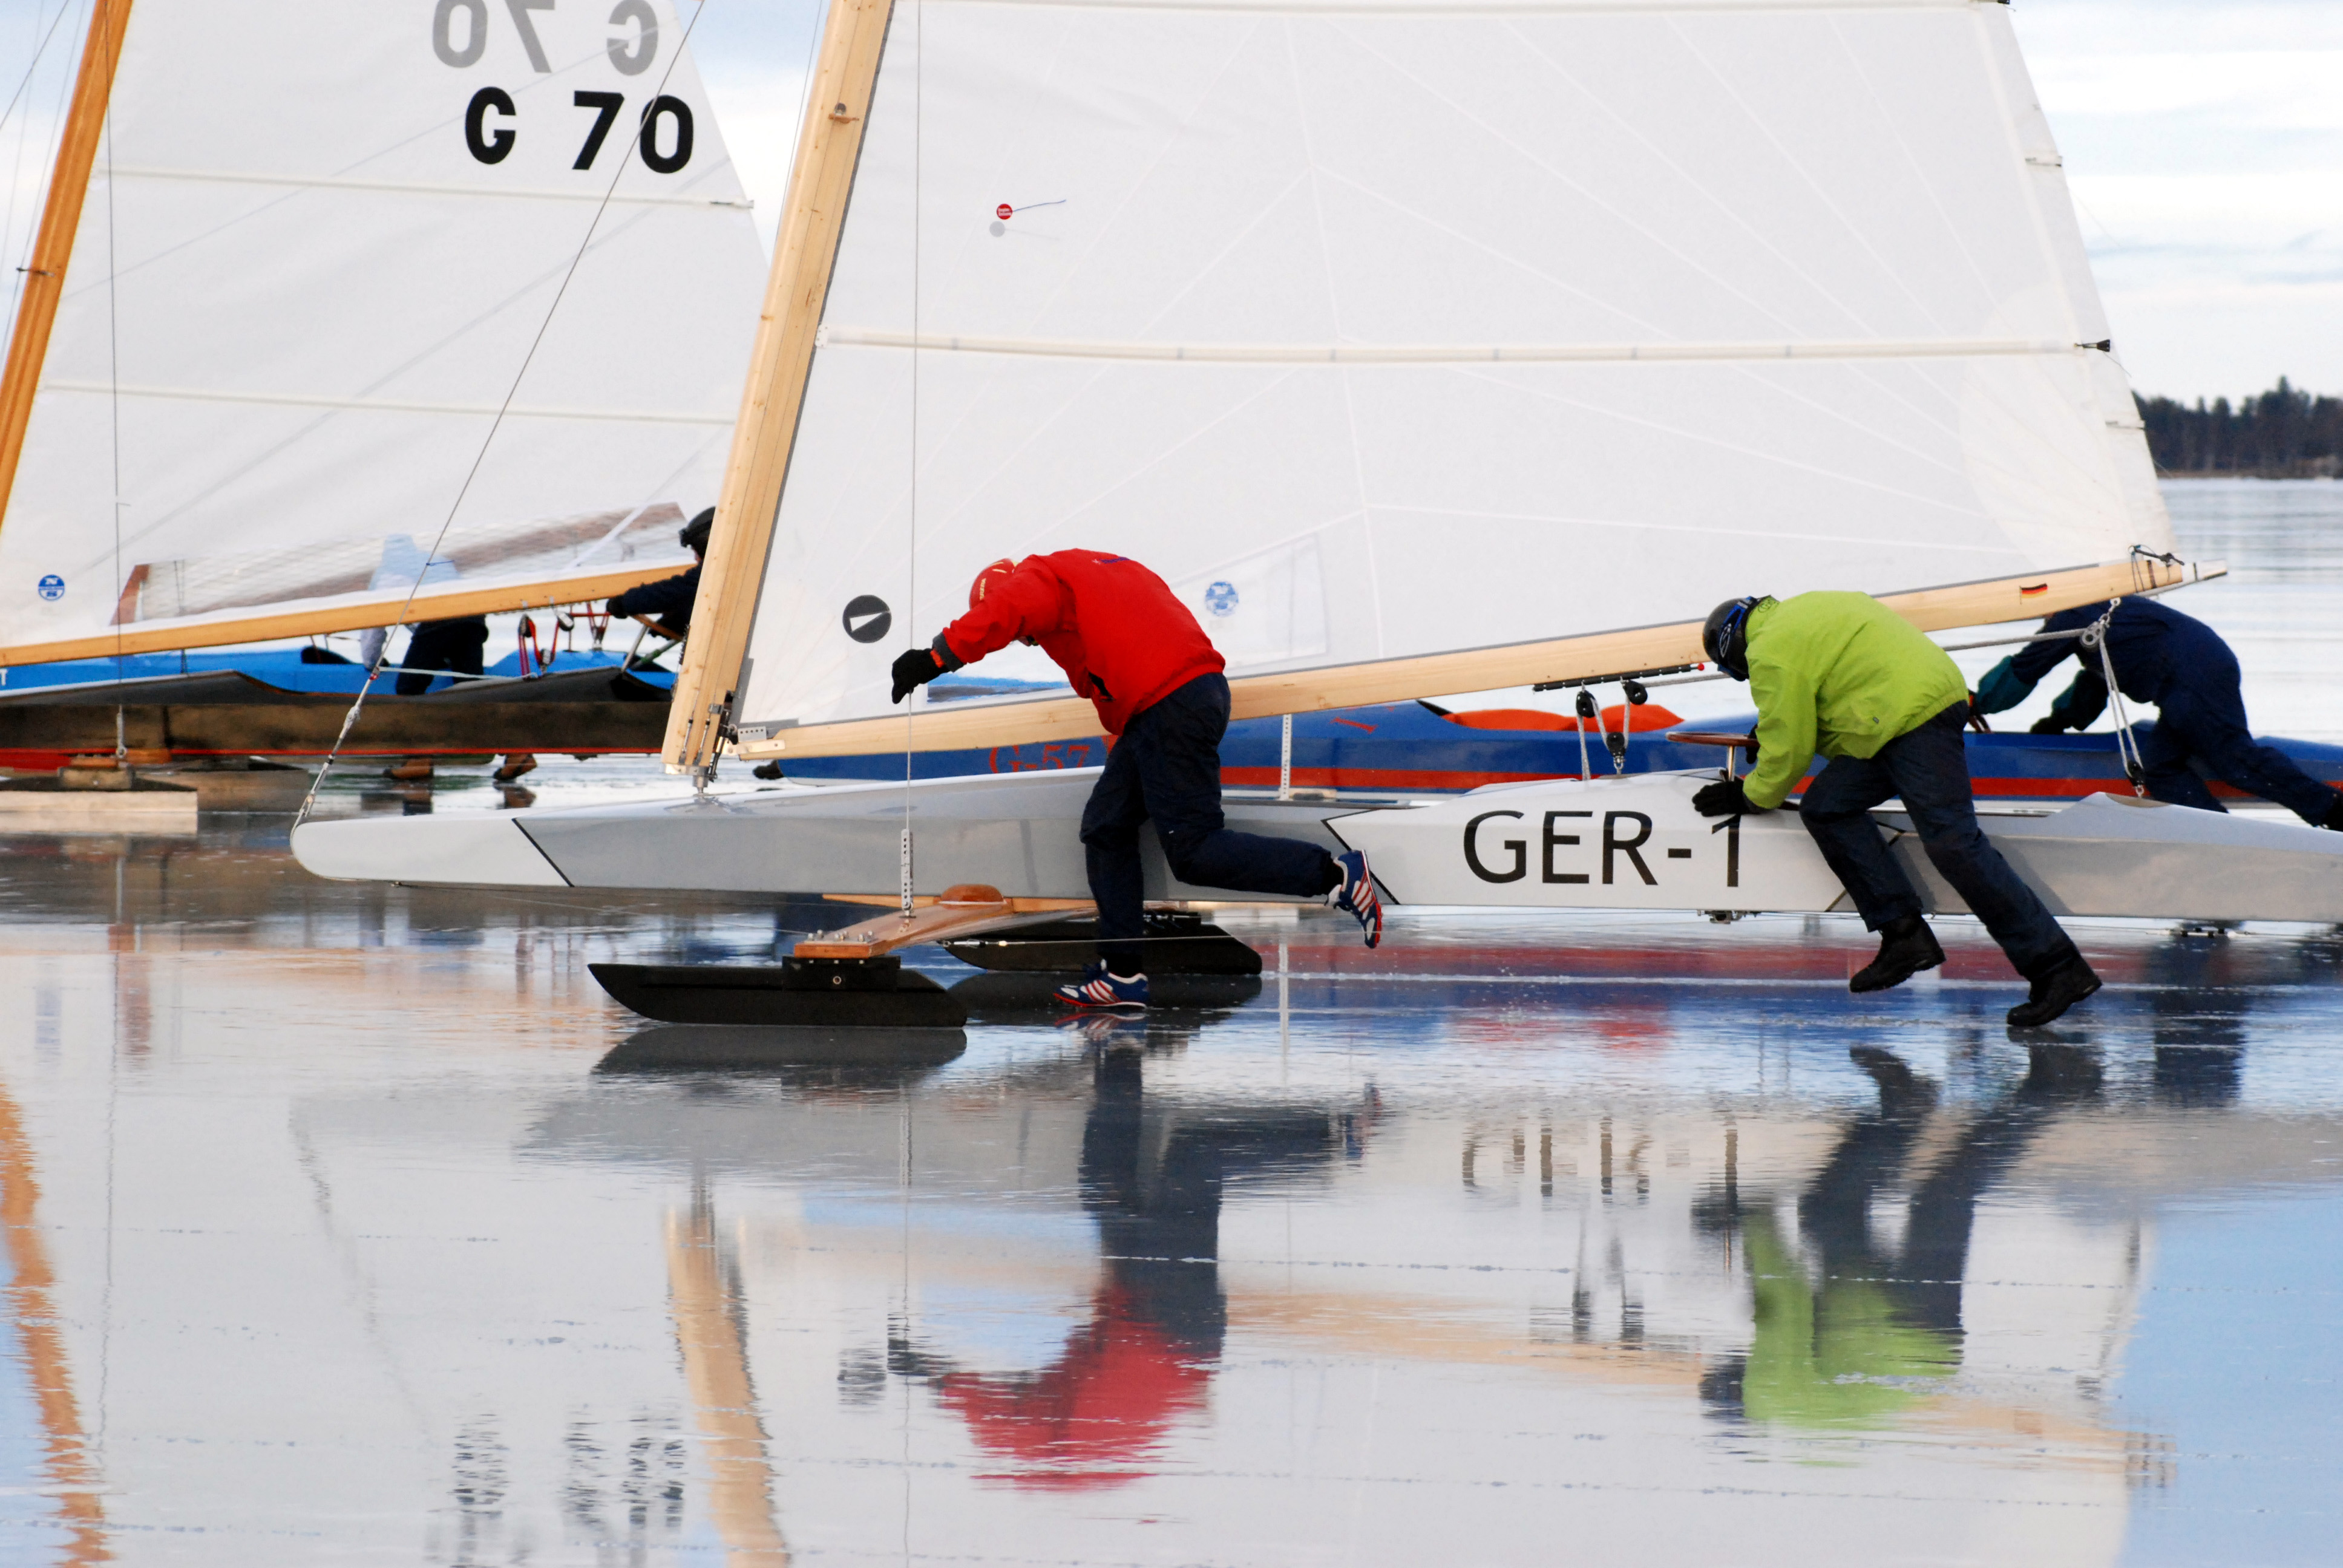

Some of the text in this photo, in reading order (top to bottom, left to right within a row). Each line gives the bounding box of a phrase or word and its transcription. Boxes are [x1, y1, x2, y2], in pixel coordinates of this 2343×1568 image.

[465, 87, 693, 174] G 70
[1464, 810, 1741, 887] GER-1
